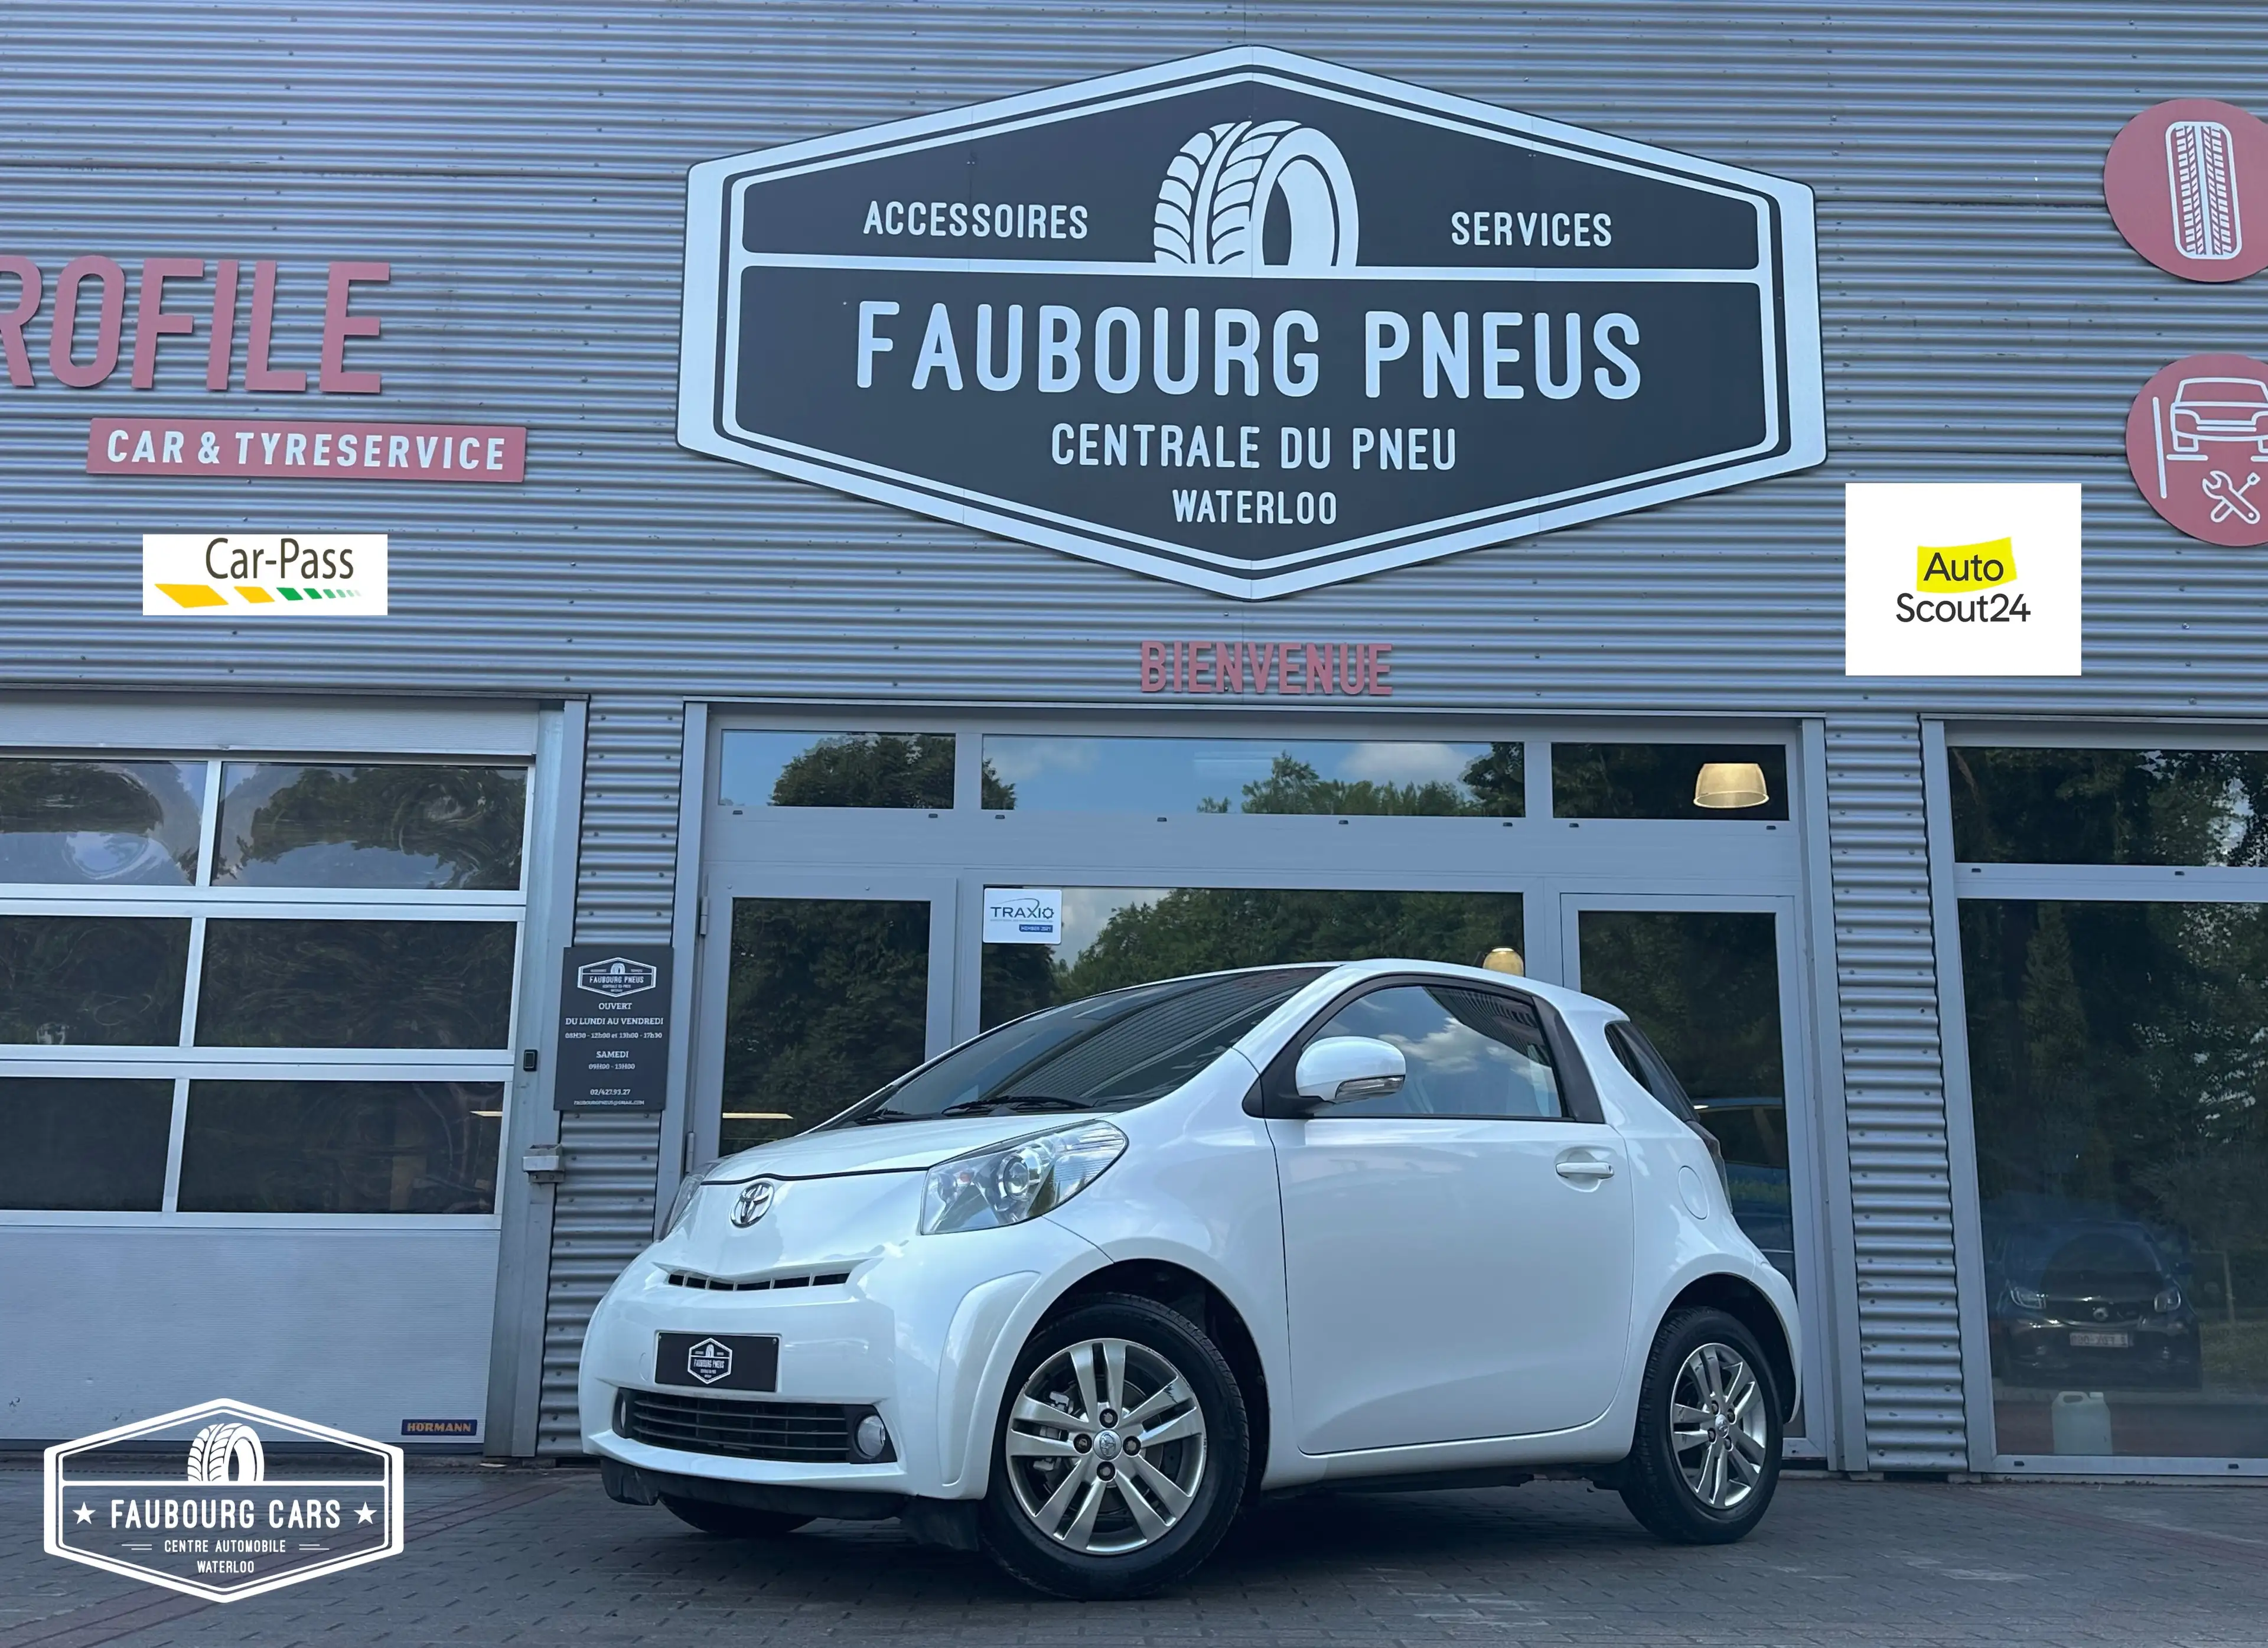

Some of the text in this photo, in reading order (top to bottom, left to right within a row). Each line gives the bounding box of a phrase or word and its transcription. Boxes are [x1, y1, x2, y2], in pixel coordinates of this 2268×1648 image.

[863, 200, 1087, 239] ACCESSOIRES
[1451, 211, 1612, 247] SERVICES
[857, 301, 1641, 400] FAUBOURG PNEUS
[107, 429, 504, 470] CAR & TYRESERVICE
[1052, 423, 1455, 470] CENTRALE DU PNEU
[1172, 489, 1337, 525] WATERLOO
[1140, 640, 1393, 695] BIENVENUE
[990, 904, 1054, 920] TRAXIO
